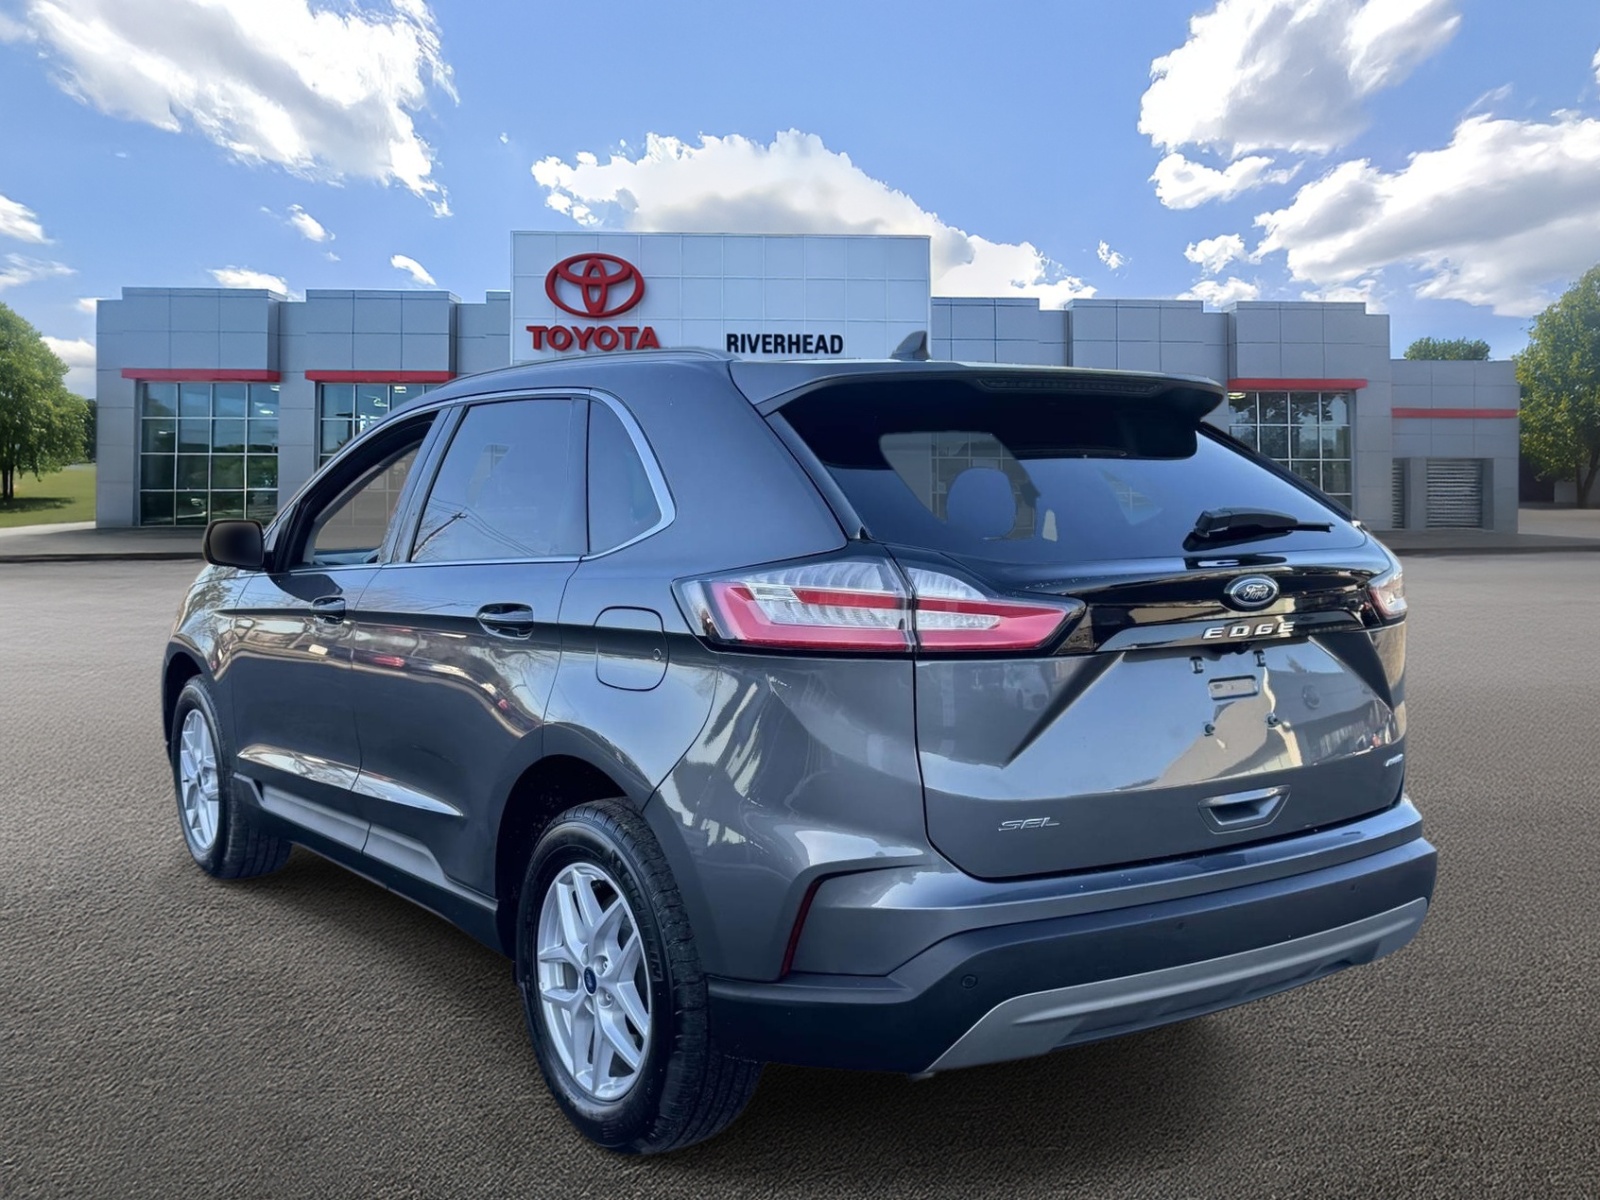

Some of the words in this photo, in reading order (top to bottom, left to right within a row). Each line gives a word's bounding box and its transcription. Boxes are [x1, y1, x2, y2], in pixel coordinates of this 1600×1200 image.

[526, 325, 661, 352] TOYOTA
[726, 333, 844, 355] RIVERHEAD
[1243, 584, 1269, 600] Ford
[1202, 621, 1295, 640] EDGE
[998, 816, 1060, 832] SEL
